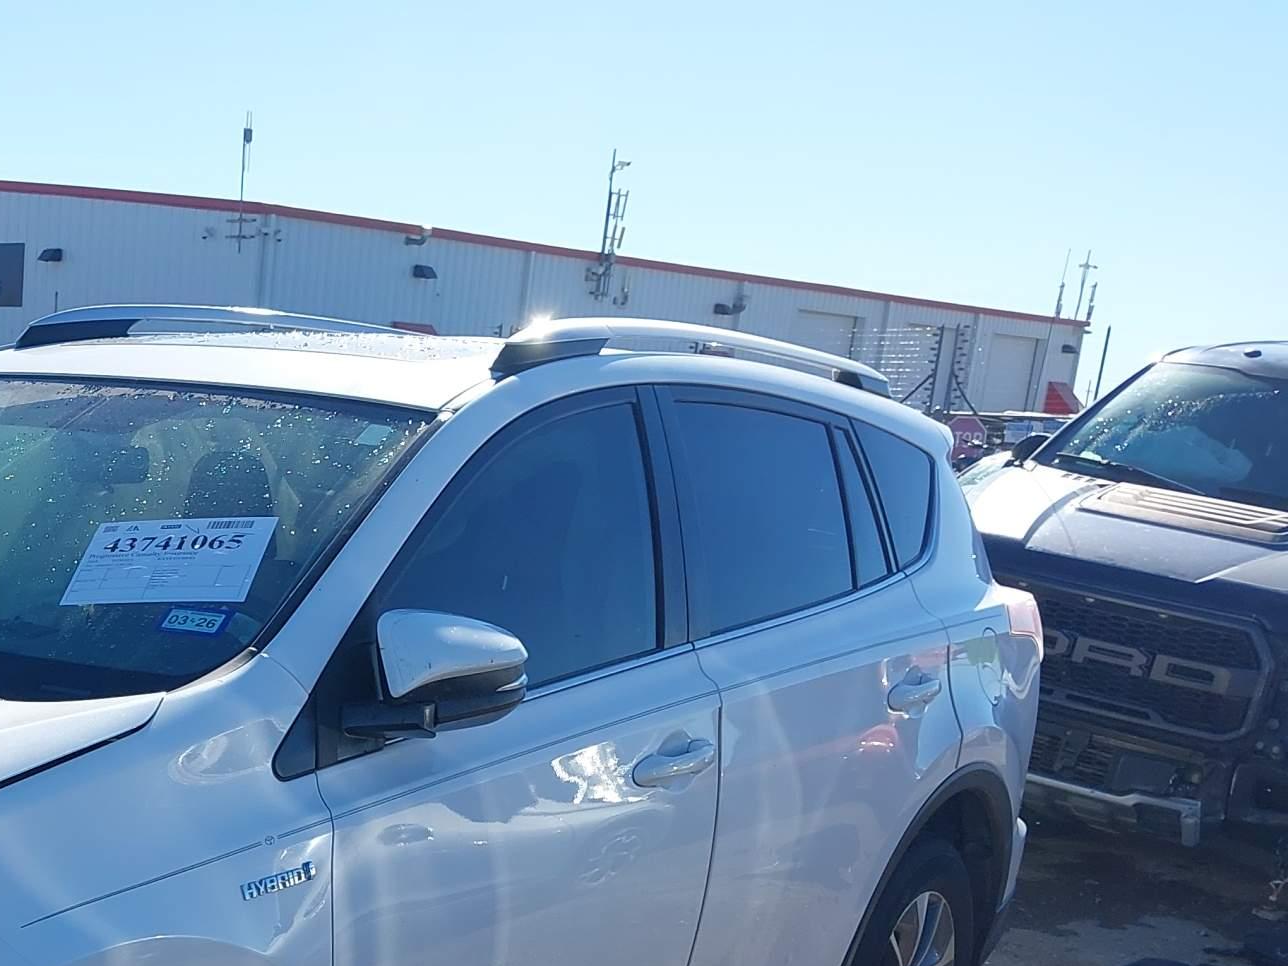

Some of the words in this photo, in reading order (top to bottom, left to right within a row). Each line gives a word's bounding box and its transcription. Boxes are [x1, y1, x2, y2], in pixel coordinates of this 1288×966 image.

[103, 534, 246, 553] 43741065
[168, 615, 189, 625] 03
[195, 618, 217, 629] 26
[1043, 629, 1232, 694] RD
[241, 865, 310, 900] HYBRID
